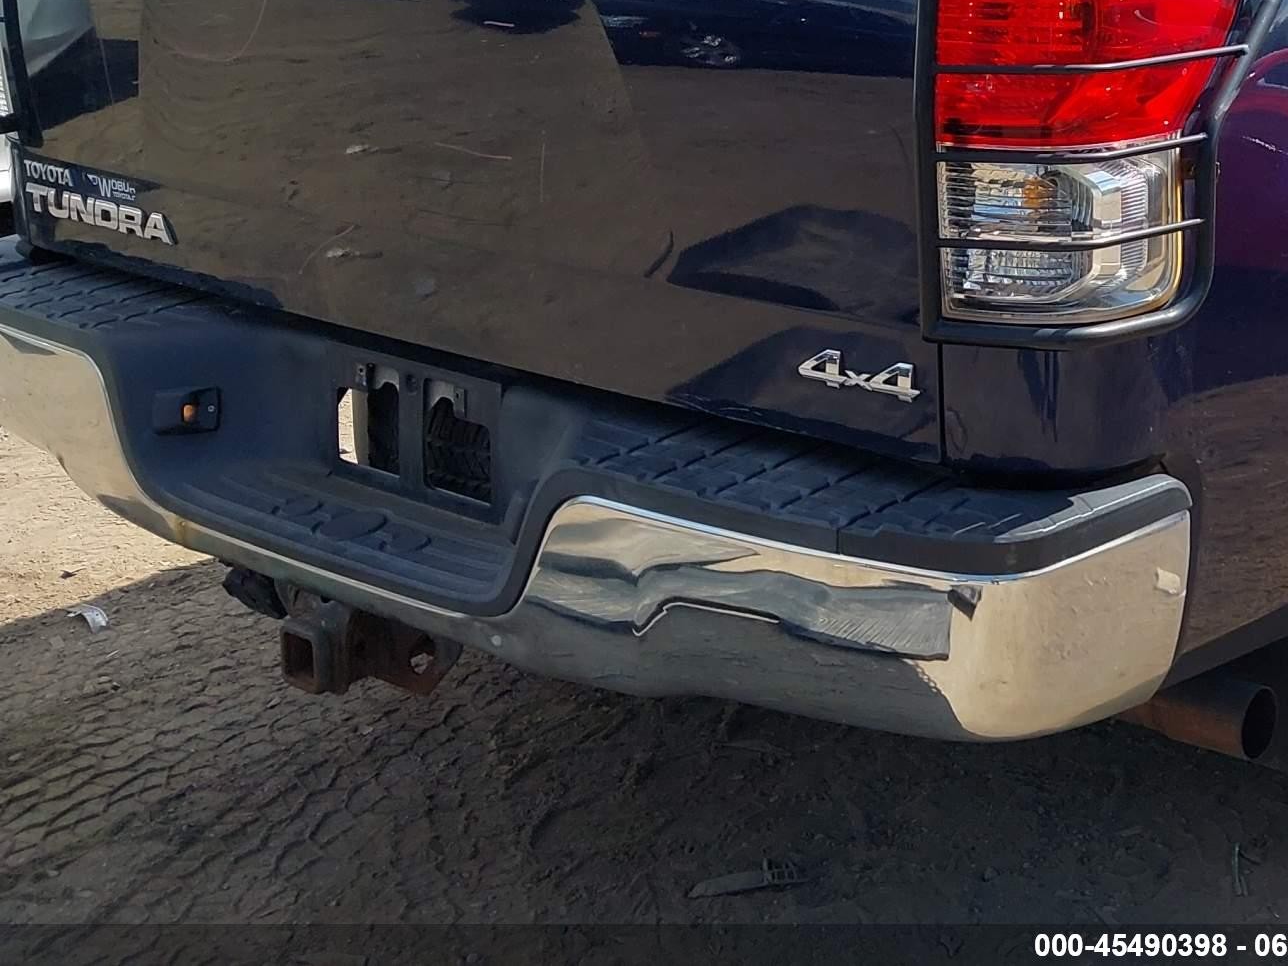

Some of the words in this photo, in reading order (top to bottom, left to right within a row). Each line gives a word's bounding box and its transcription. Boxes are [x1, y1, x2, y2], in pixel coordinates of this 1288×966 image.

[24, 159, 73, 187] TOYOTA
[25, 182, 177, 245] TUNDRA
[798, 349, 921, 403] 4x4
